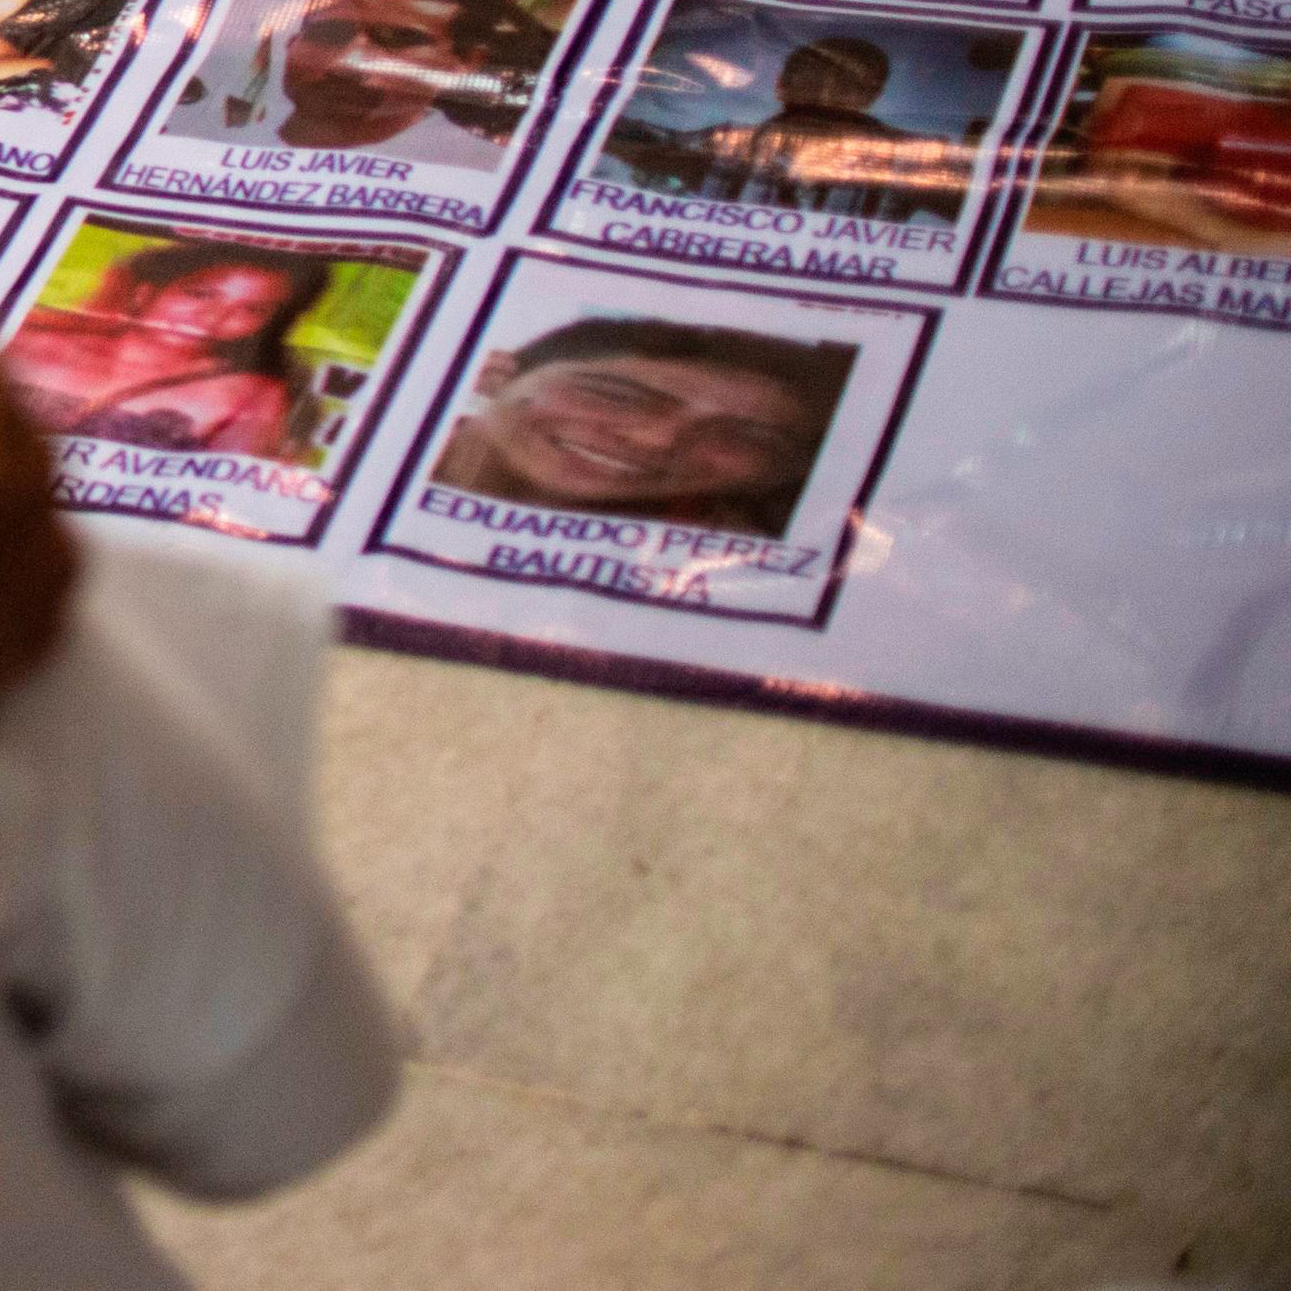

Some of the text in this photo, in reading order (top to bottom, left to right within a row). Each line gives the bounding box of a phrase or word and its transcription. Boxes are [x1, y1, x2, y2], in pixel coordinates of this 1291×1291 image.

[219, 147, 413, 182] LUIS JAVIER
[120, 162, 487, 229] HERNÁNDEZ BARRERA
[569, 178, 958, 254] FRANCISCO JAVIER
[601, 221, 898, 280] CABRERA MAR
[1075, 241, 1167, 272] LUIS
[999, 265, 1205, 306] CALLEJAS
[419, 487, 823, 579] EDUARDO PEREZ
[485, 543, 712, 604] BAUTISTA
